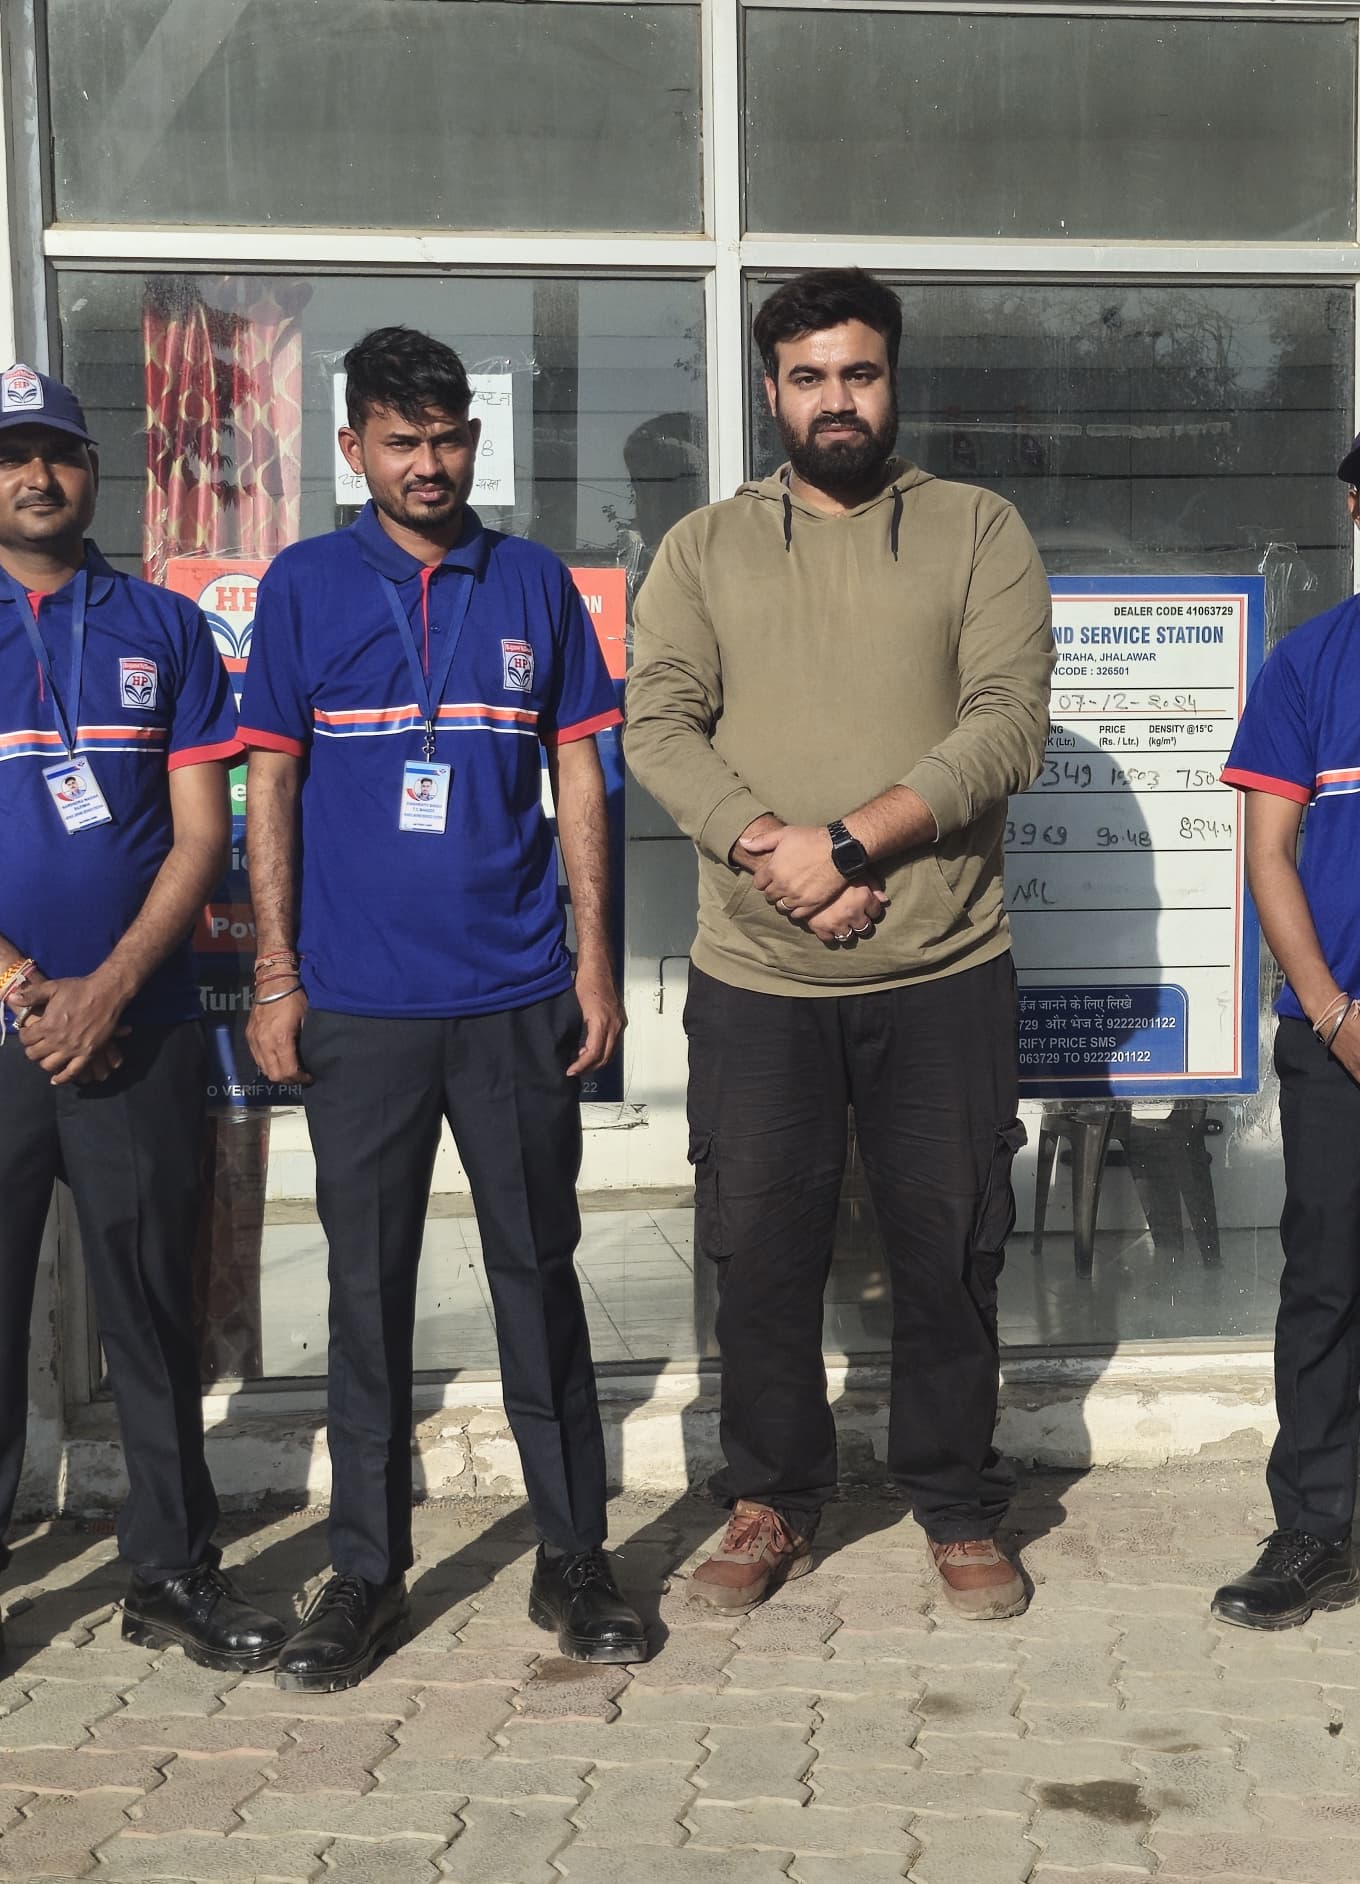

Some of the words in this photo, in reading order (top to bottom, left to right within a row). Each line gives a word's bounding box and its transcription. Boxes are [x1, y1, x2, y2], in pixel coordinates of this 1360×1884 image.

[1114, 607, 1153, 616] DEALER
[1156, 606, 1183, 616] CODE
[1186, 606, 1233, 616] 41063729
[1080, 626, 1150, 644] SERVICE
[1156, 626, 1224, 644] STATION
[1099, 653, 1157, 661] JHALAWAR
[514, 658, 528, 668] HP
[1096, 667, 1129, 675] 326501
[132, 676, 148, 687] HP
[1099, 726, 1126, 734] PRICE
[1149, 725, 1185, 734] DENSITY
[1056, 737, 1076, 747] (Ltr.)
[1099, 737, 1115, 747] (Rs.
[1122, 737, 1139, 747] Ltr.)
[211, 917, 255, 939] Po
[1106, 1017, 1176, 1030] 9222201122
[1019, 1038, 1046, 1049] RIFY
[1050, 1037, 1087, 1049] PRICE
[1090, 1037, 1117, 1048] SMS
[1019, 1053, 1060, 1064] 063729
[1063, 1052, 1080, 1063] TO
[1083, 1051, 1151, 1063] 9222201122
[223, 1084, 273, 1096] VERIFY
[583, 1082, 598, 1093] 22
